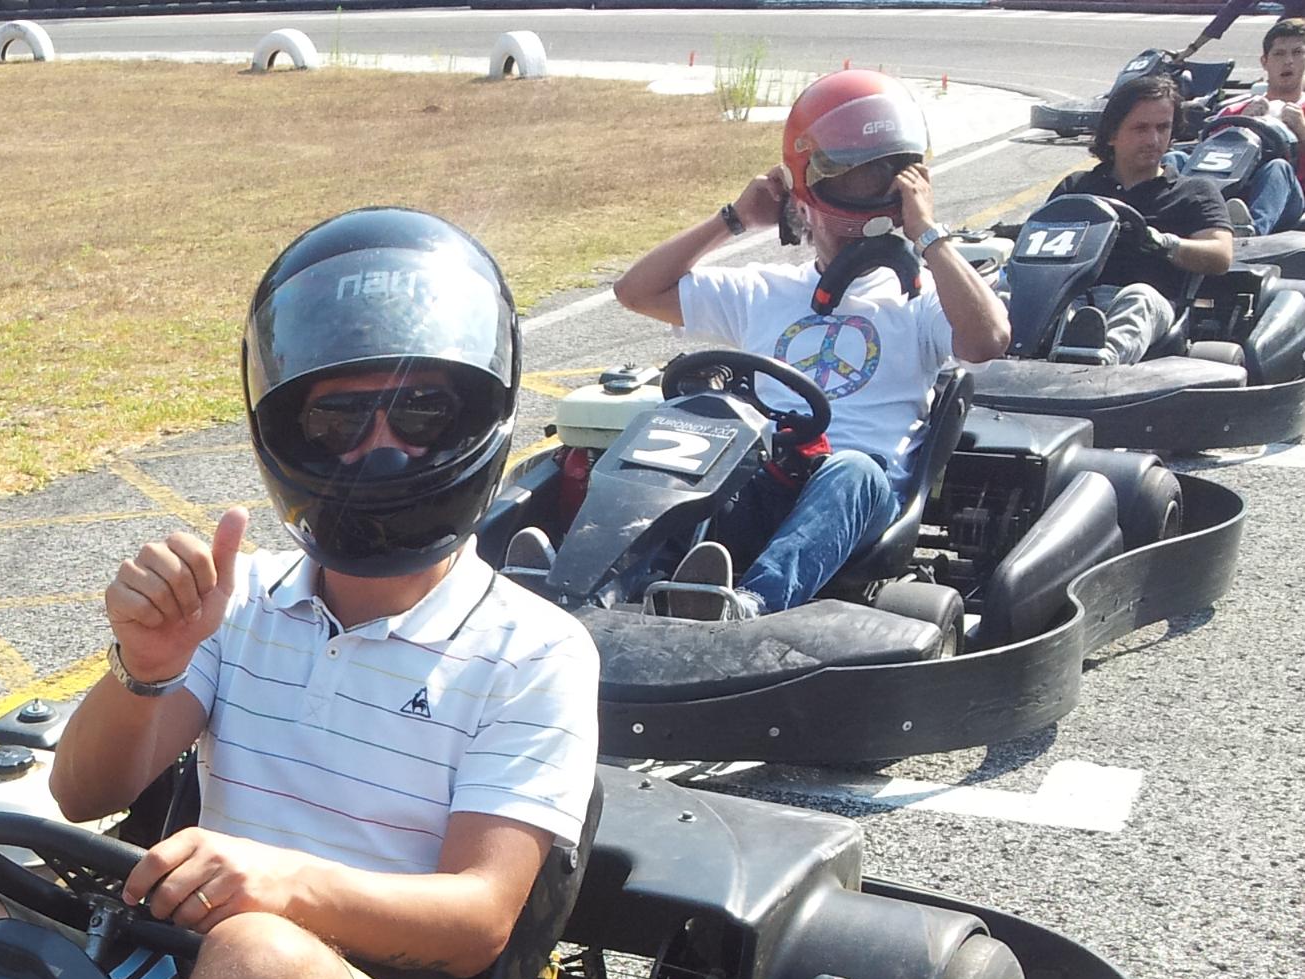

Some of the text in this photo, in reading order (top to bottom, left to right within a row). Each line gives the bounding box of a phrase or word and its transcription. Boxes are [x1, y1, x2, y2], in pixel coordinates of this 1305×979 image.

[1126, 60, 1150, 71] 10
[1196, 151, 1234, 170] 5
[1025, 230, 1077, 255] 14
[632, 429, 711, 471] 2
